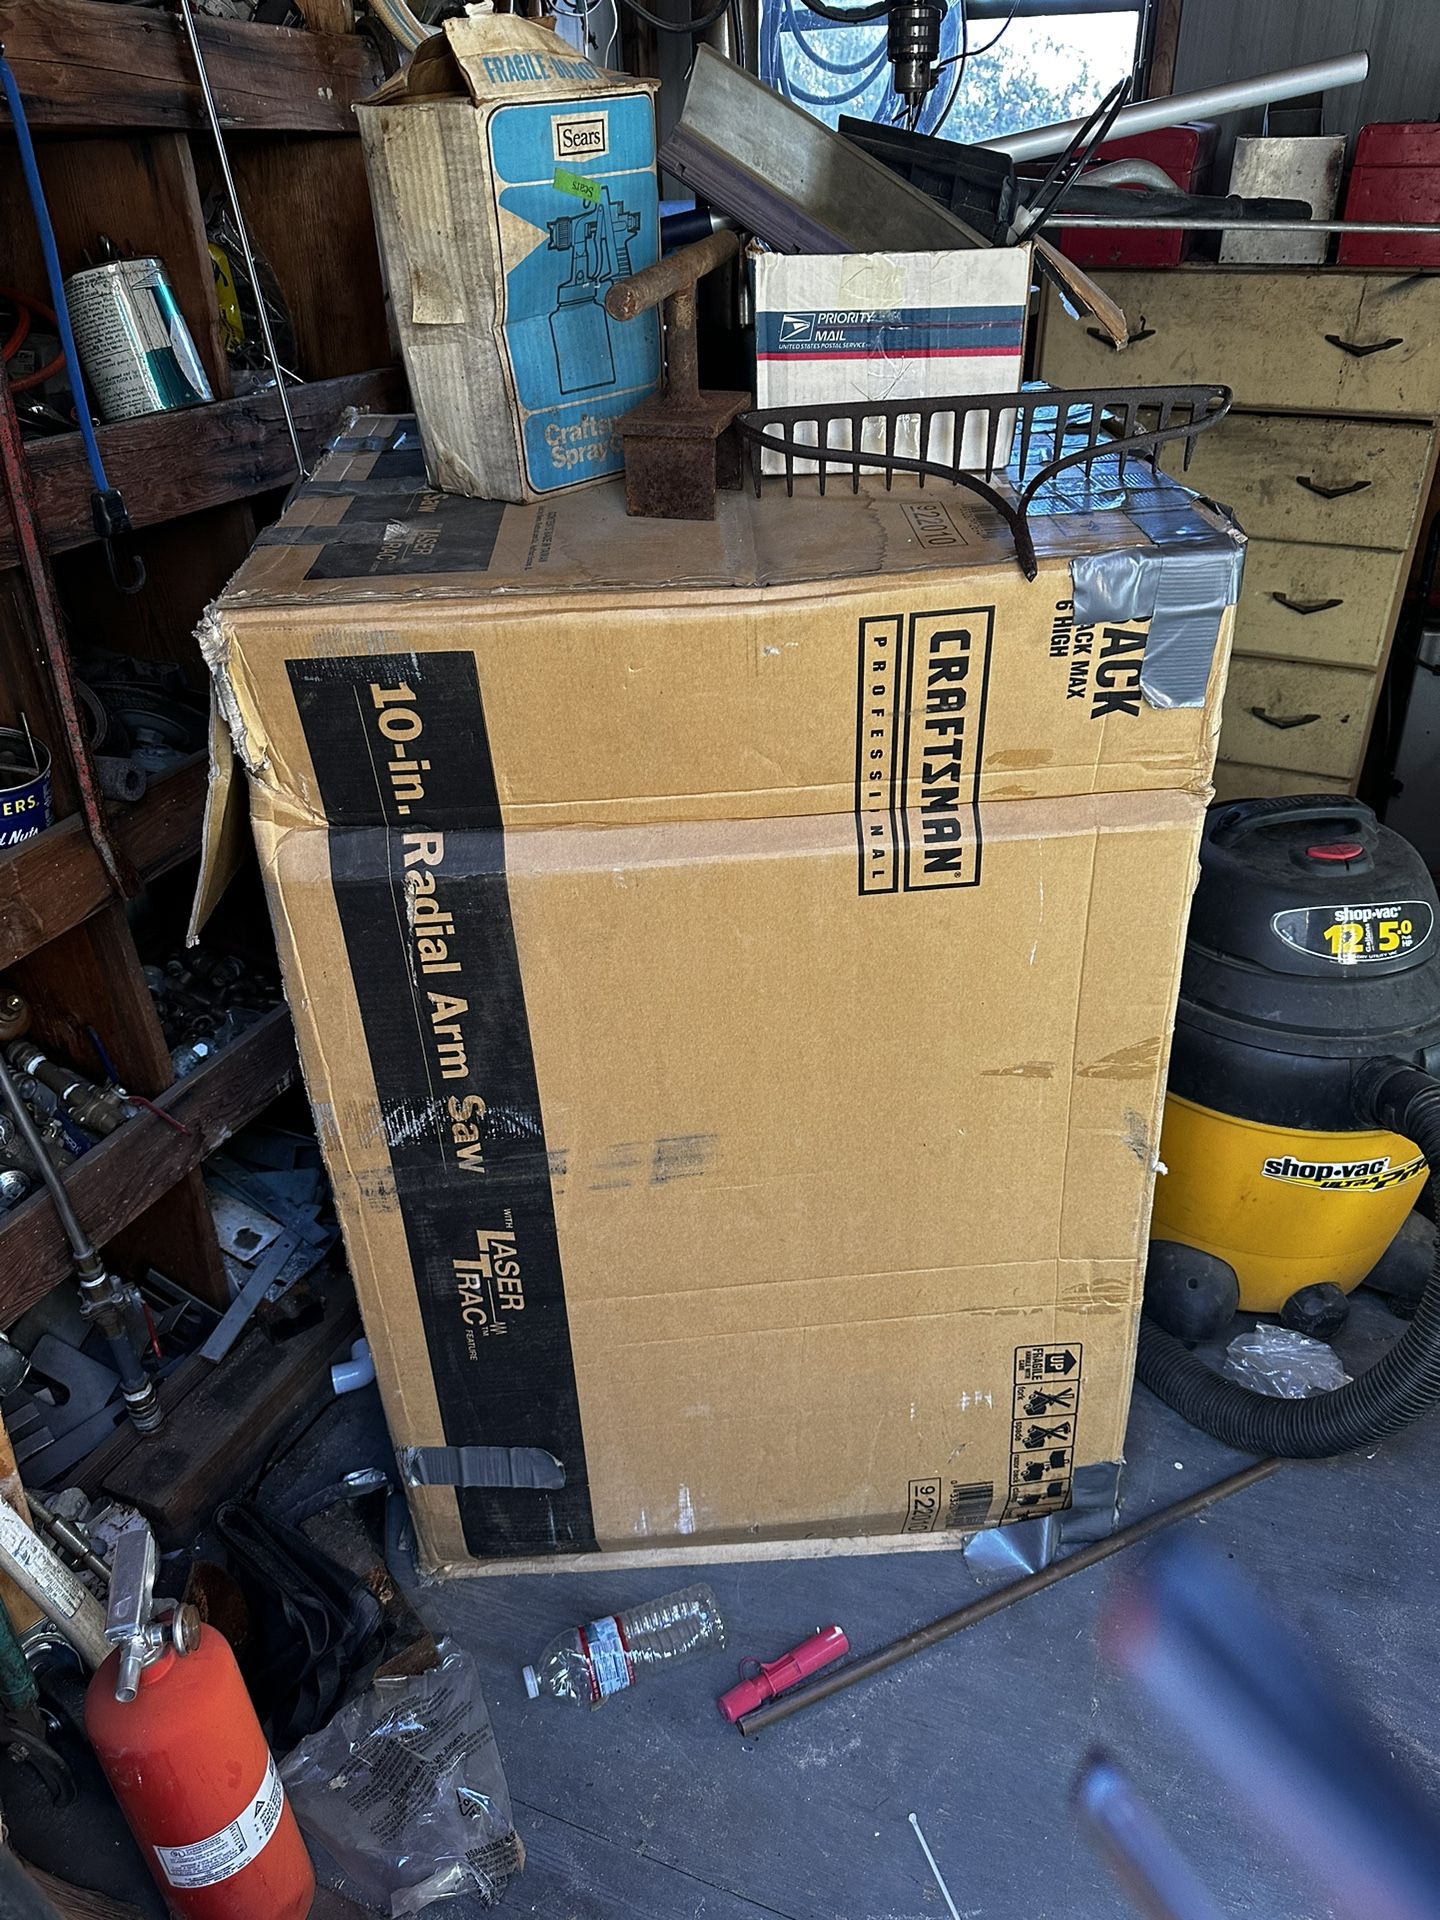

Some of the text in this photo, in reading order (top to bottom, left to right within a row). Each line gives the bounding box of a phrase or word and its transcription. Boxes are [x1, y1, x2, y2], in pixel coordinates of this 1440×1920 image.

[482, 51, 551, 83] FRAGILE
[562, 128, 601, 148] Sears
[572, 181, 595, 198] Sears
[817, 312, 874, 325] PRIORITY
[815, 330, 847, 342] MAIL
[841, 341, 866, 349] SERVICE
[551, 442, 608, 470] Spray
[418, 494, 449, 513] Saw
[910, 505, 957, 545] 922010
[1050, 600, 1074, 657] 6 HIGH
[1067, 624, 1095, 700] ACK MAX
[1091, 616, 1153, 719] ACK
[868, 636, 888, 879] PROFESSINAL
[370, 680, 487, 1175] 10-in. Radial Arm Saw
[1323, 923, 1365, 954] 12
[1320, 1176, 1379, 1189] ULTRA
[503, 1208, 514, 1229] WITH
[476, 1230, 526, 1311] LASER
[452, 1253, 493, 1325] TRAC
[465, 1329, 478, 1361] FEATURE
[1031, 1348, 1043, 1381] FRAGILE
[1050, 1355, 1064, 1370] UP
[1017, 1386, 1026, 1400] fork
[1014, 1421, 1022, 1441] spade
[908, 1485, 936, 1531] 922010
